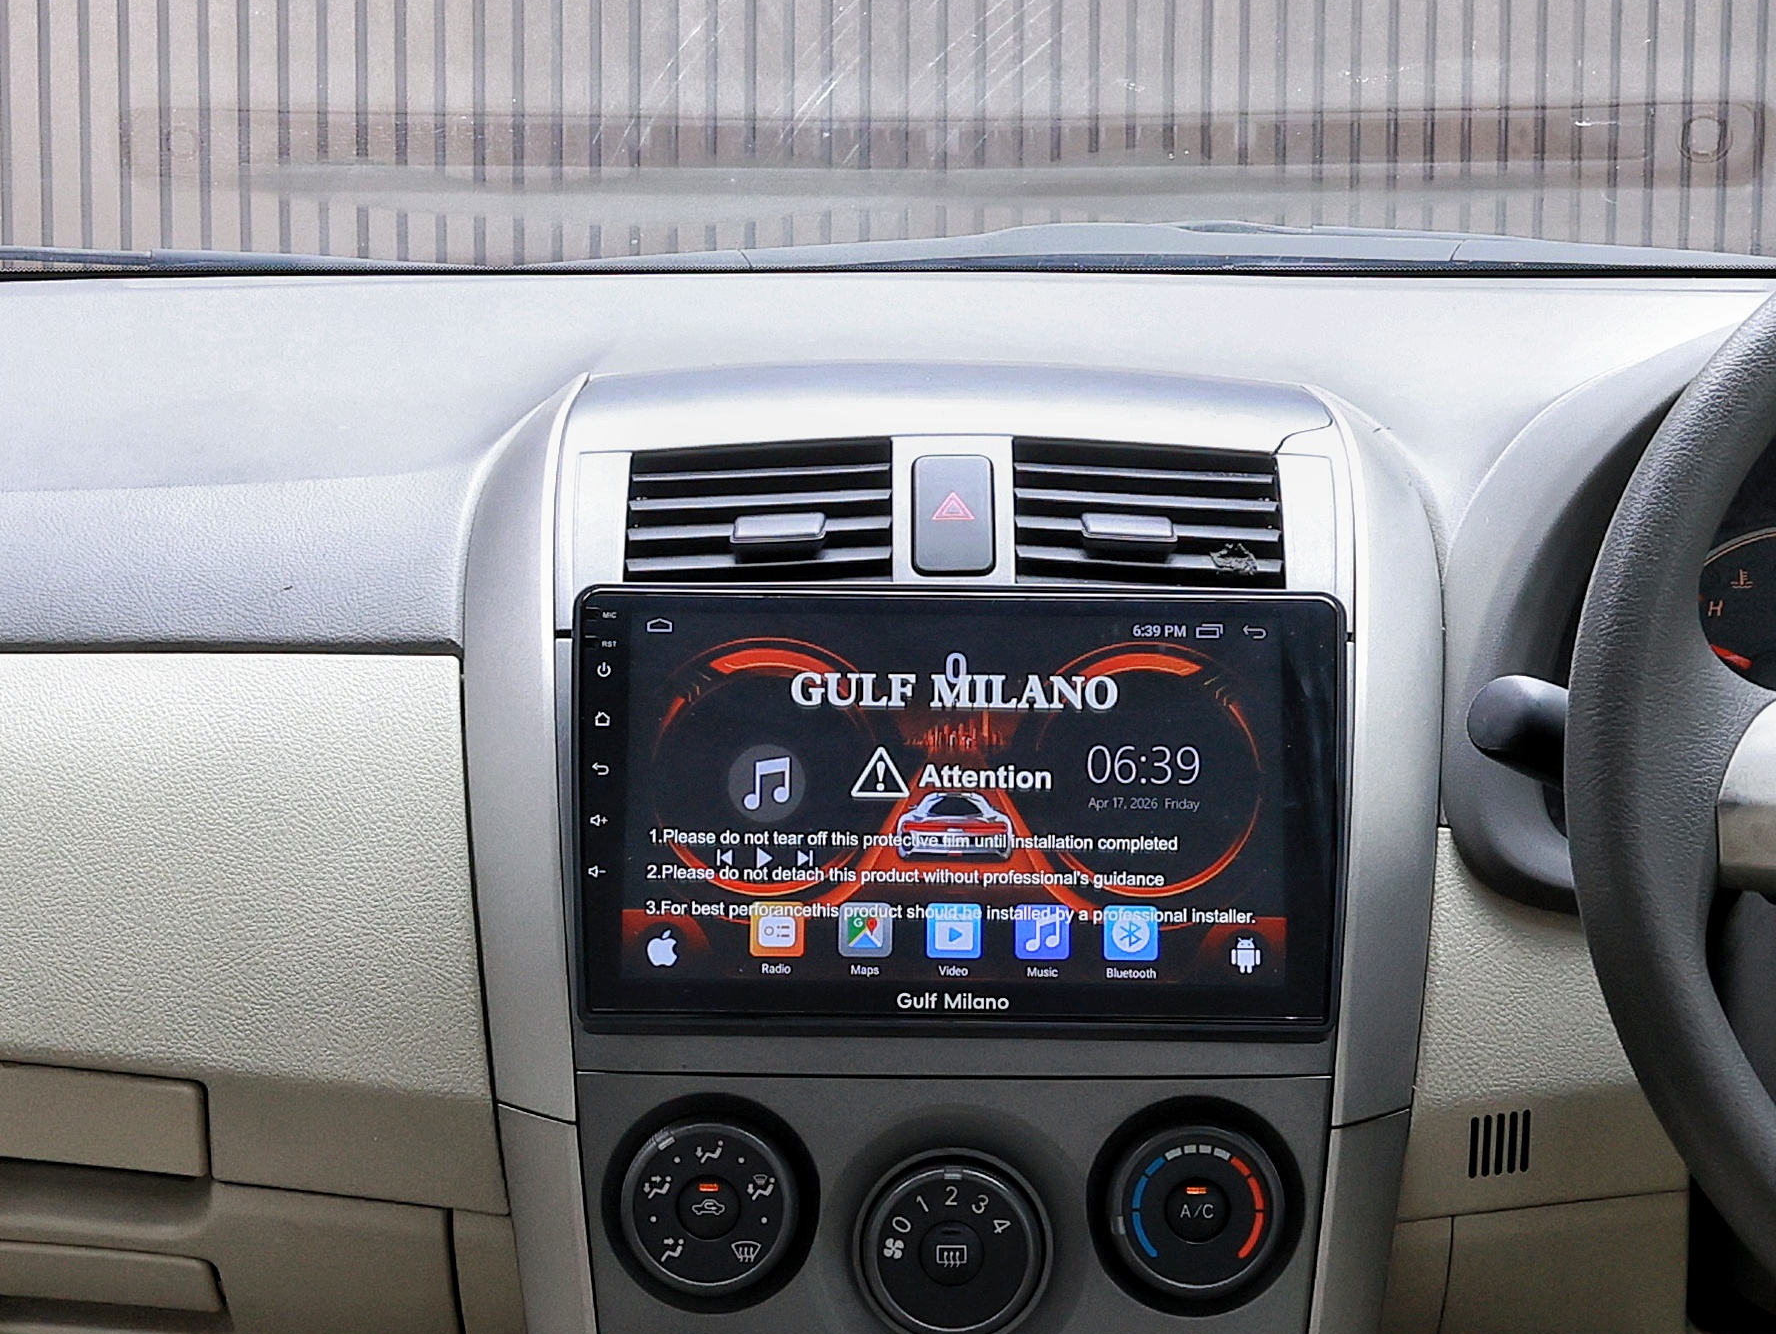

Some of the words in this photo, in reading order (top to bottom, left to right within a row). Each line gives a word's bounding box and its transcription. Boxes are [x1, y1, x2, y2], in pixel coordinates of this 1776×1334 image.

[1707, 600, 1724, 617] H
[1132, 624, 1161, 639] 6:39
[1165, 624, 1187, 638] PM
[790, 672, 916, 707] GULF
[930, 673, 1119, 710] MILANO
[1087, 745, 1200, 786] 06:39
[919, 765, 1052, 789] Attention
[1088, 797, 1109, 811] Apr
[1112, 797, 1128, 811] 17,
[1130, 798, 1158, 809] 2026
[1165, 798, 1200, 811] Friday
[649, 829, 716, 845] 1.Please
[720, 830, 740, 845] do
[744, 831, 769, 845] not
[773, 831, 804, 846] tear
[807, 831, 828, 846] off
[831, 831, 858, 846] this
[863, 832, 938, 849] protective
[975, 834, 1006, 849] until
[1010, 835, 1093, 850] installation
[1098, 835, 1178, 852] completed
[647, 865, 715, 880] 2.Please
[719, 865, 740, 880] do
[744, 866, 768, 881] not
[772, 867, 824, 881] detach
[829, 867, 856, 882] this
[861, 868, 920, 885] product
[923, 868, 979, 883] without
[983, 869, 1089, 887] professional's
[1093, 871, 1165, 888] guidance
[646, 901, 687, 916] 3.For
[691, 901, 724, 917] best
[844, 903, 903, 920] product
[986, 906, 1052, 921] installed
[1055, 907, 1073, 924] by
[1078, 911, 1088, 922] a
[1093, 907, 1188, 925] professional
[1191, 908, 1256, 924] installer.
[761, 963, 791, 974] Radio
[850, 965, 879, 977] Maps
[938, 965, 968, 976] Video
[1027, 967, 1058, 978] Music
[1106, 967, 1157, 979] Bluetooth
[897, 993, 937, 1009] Gulf
[944, 993, 1009, 1010] Milano
[890, 1215, 912, 1235] 0
[917, 1194, 929, 1213] 1
[944, 1186, 959, 1208] 2
[971, 1194, 990, 1215] 3
[991, 1217, 1011, 1236] 4
[1180, 1204, 1215, 1220] A/C
